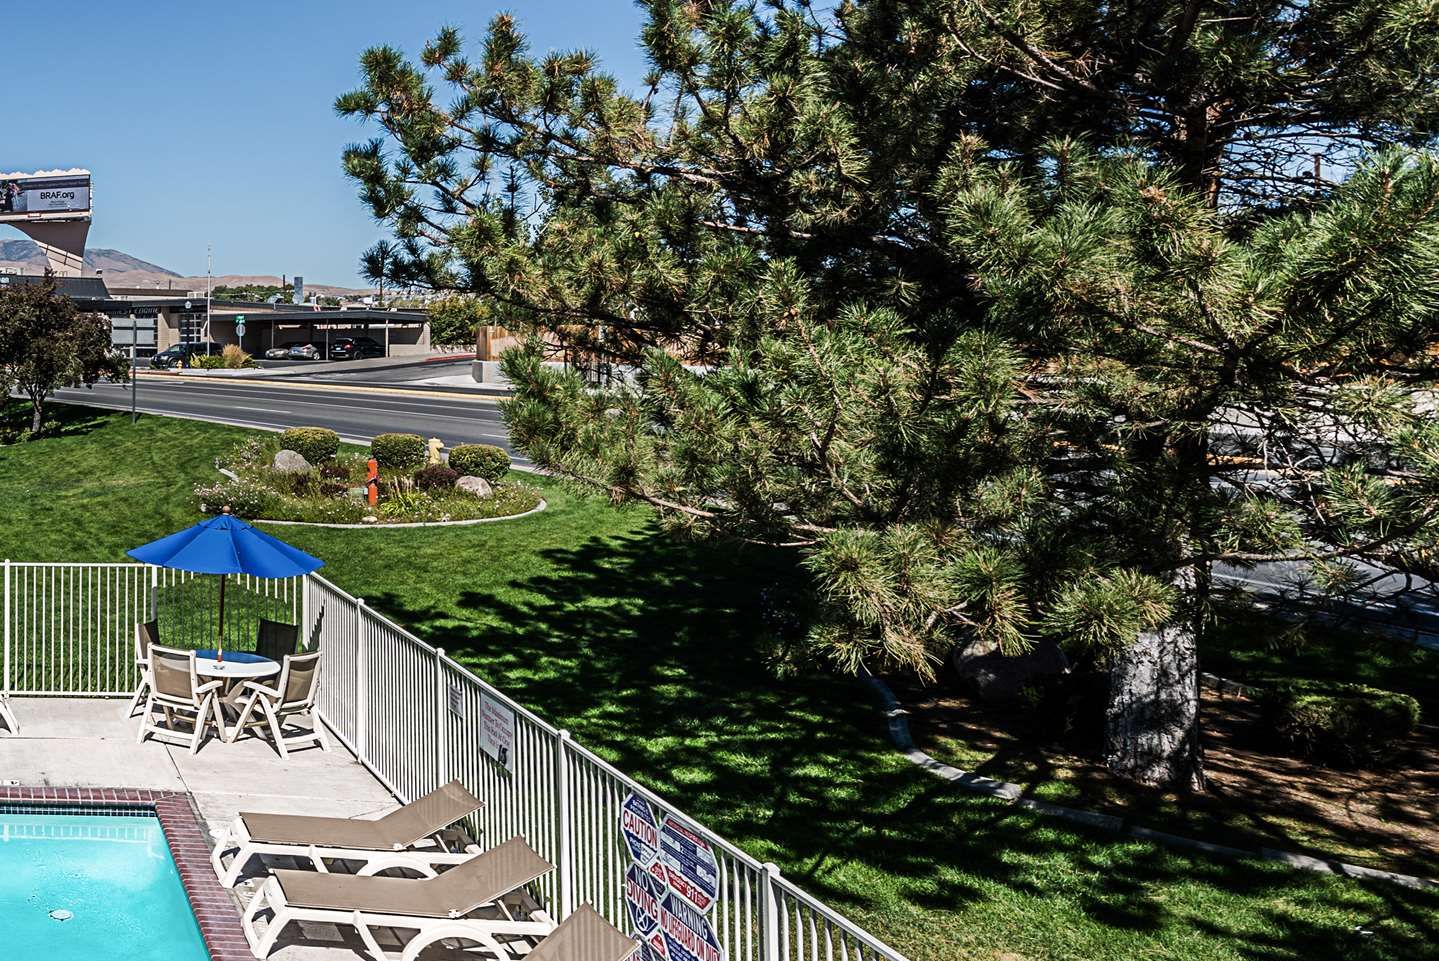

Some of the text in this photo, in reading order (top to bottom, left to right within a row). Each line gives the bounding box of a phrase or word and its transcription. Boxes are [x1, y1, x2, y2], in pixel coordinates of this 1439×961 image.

[40, 191, 75, 200] BRAF.org
[623, 810, 657, 849] CAUTION
[634, 863, 649, 892] NO
[686, 885, 698, 903] 911
[626, 880, 658, 919] DIVING
[670, 893, 708, 941] WARNING
[660, 907, 669, 930] NO
[668, 912, 696, 952] LIFEGUARD
[695, 935, 705, 961] ON
